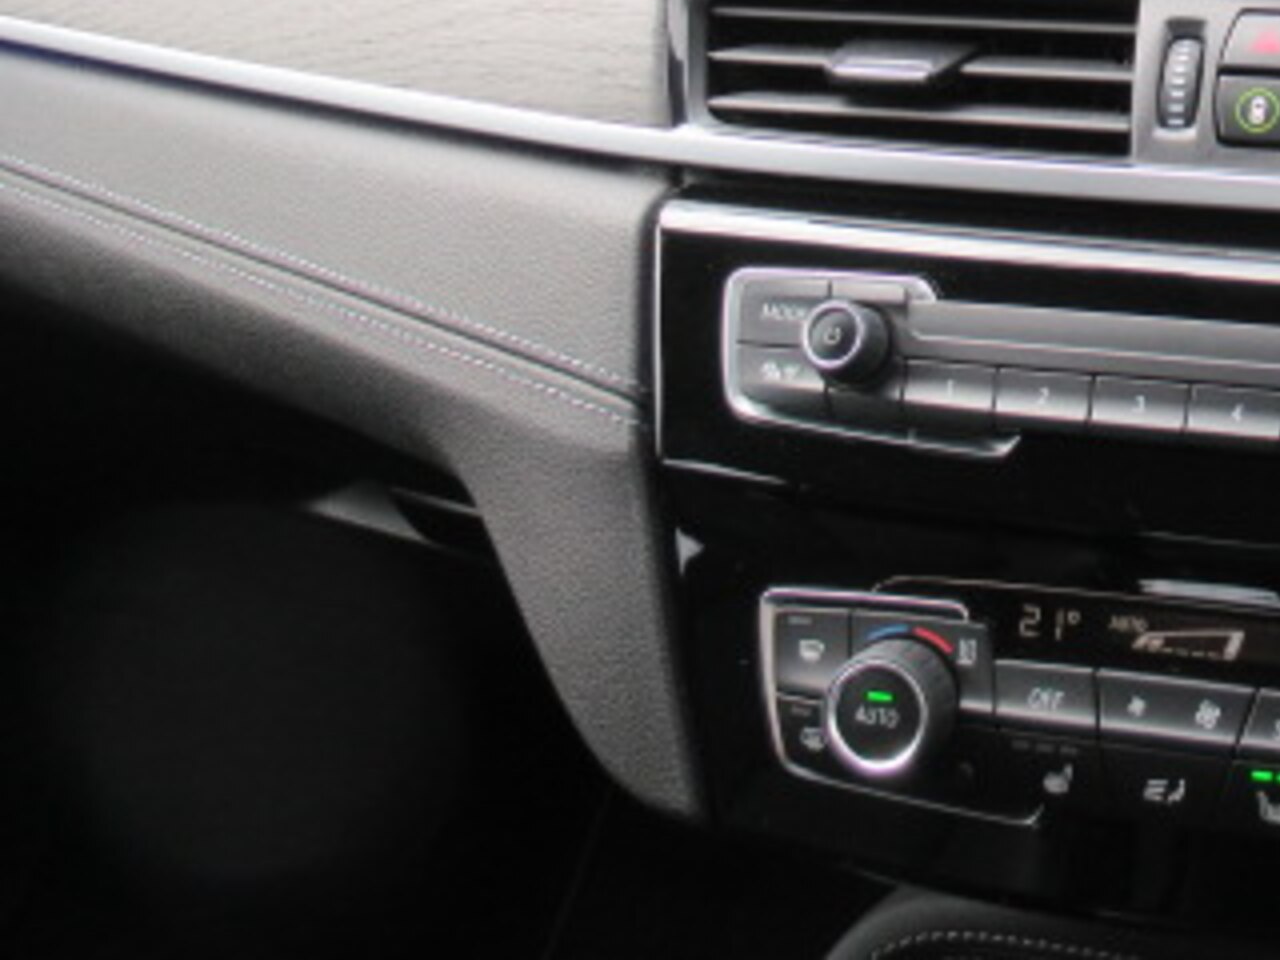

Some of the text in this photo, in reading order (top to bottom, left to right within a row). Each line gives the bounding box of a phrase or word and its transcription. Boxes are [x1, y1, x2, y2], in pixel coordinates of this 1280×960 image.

[946, 379, 953, 398] 1
[1038, 387, 1050, 405] 2
[1136, 395, 1146, 413] 3
[1231, 403, 1244, 421] 4
[1027, 687, 1065, 710] OFF
[855, 704, 901, 729] AUTO
